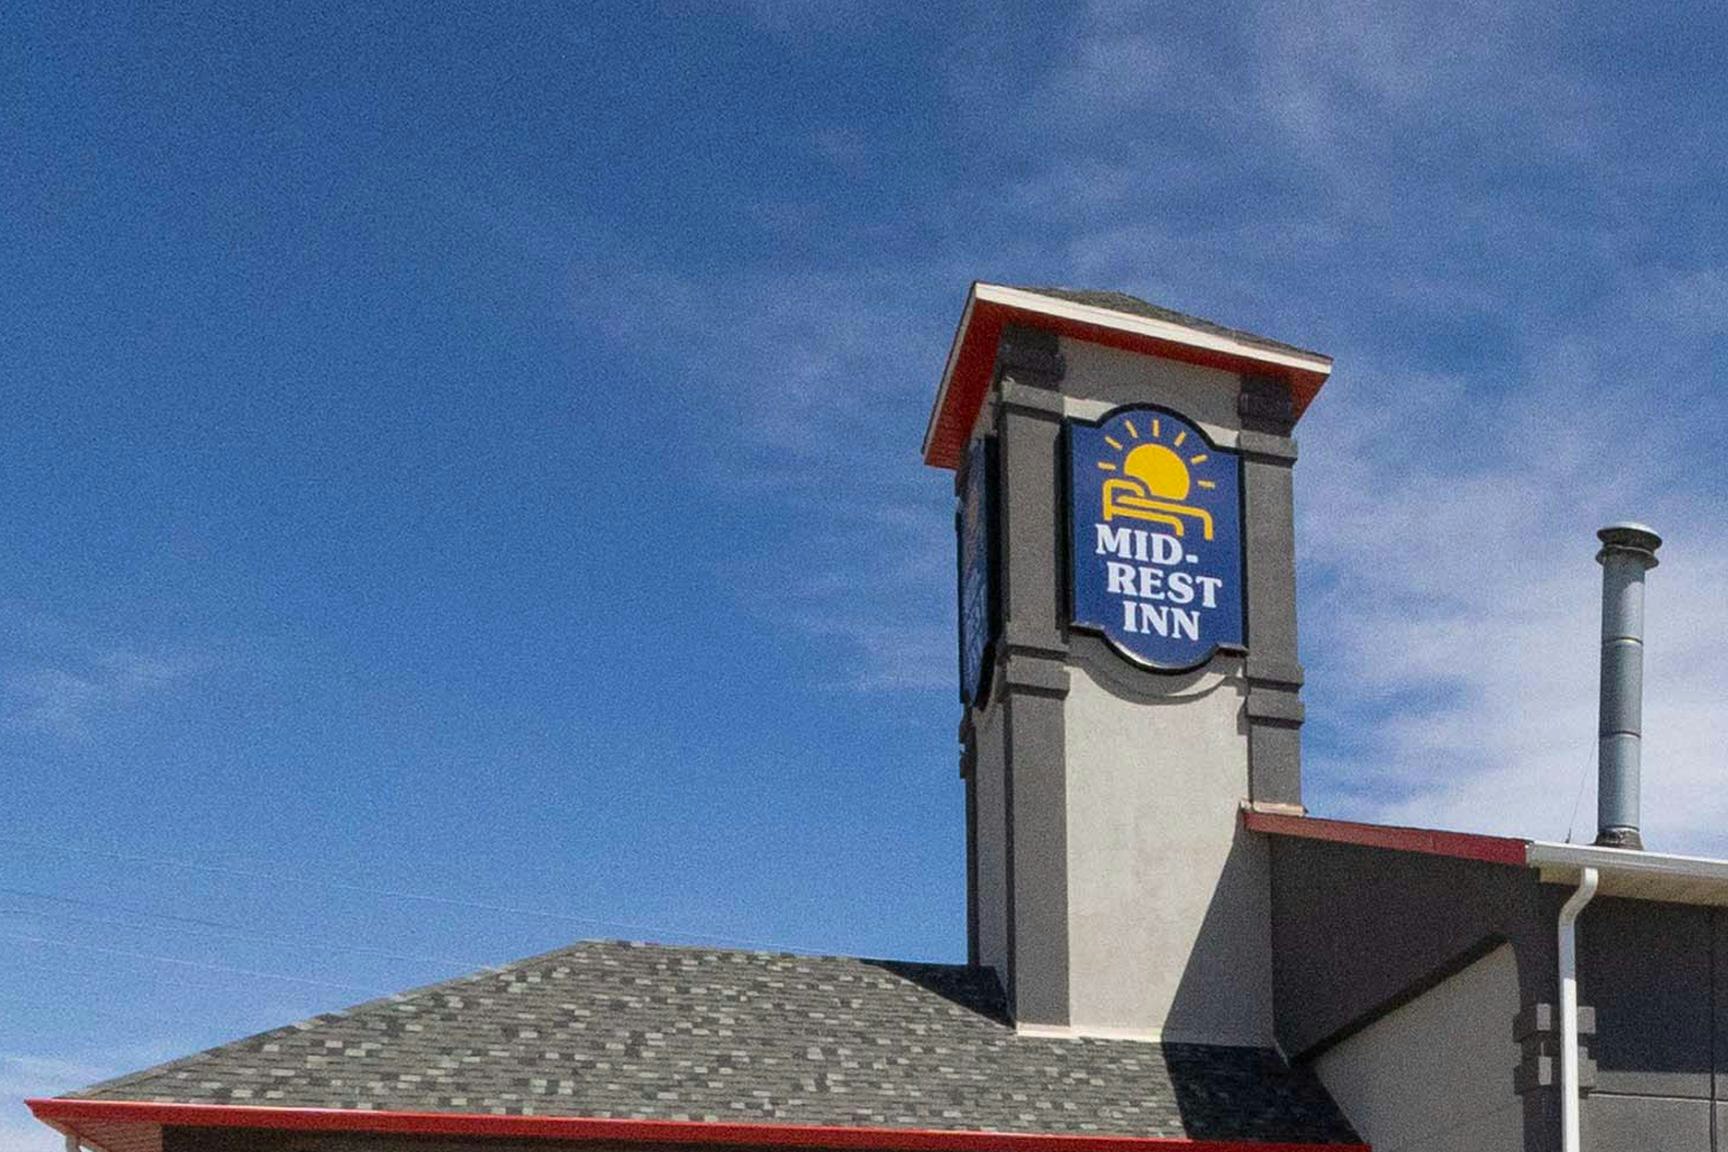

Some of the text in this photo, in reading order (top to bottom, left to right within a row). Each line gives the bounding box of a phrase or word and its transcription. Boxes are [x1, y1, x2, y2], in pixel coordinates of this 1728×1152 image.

[1095, 523, 1199, 565] MID-
[1106, 561, 1223, 608] REST
[1122, 600, 1200, 641] INN
